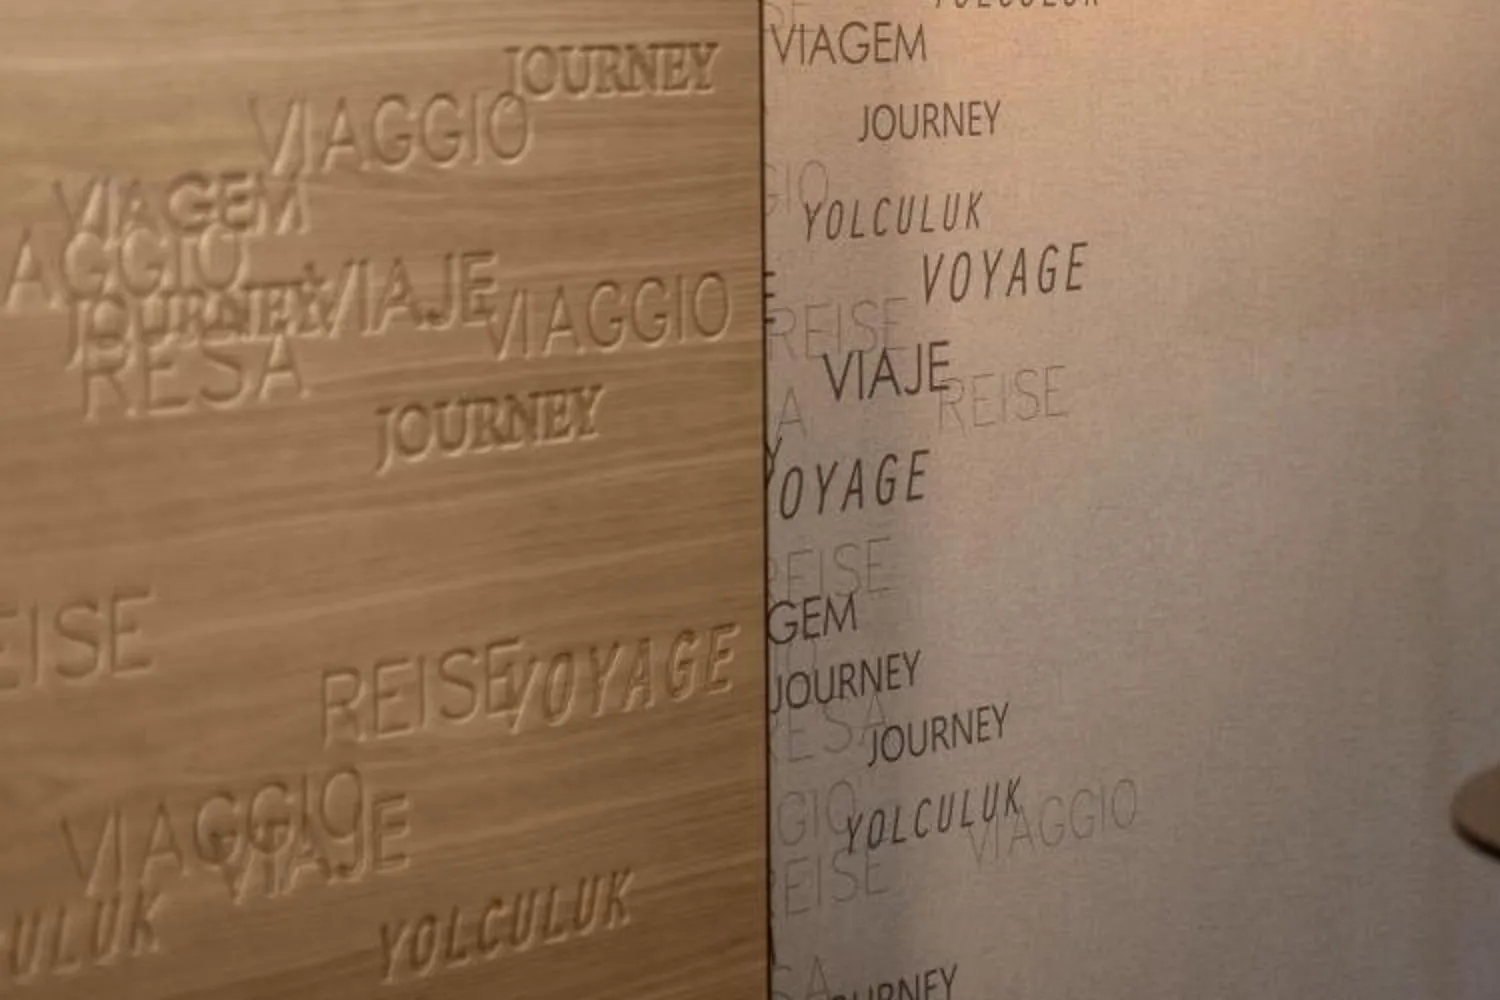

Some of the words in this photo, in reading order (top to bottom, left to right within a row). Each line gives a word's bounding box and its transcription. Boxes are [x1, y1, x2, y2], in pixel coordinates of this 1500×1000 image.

[504, 43, 719, 100] JOURNEY
[769, 20, 928, 65] VIAGEM
[247, 91, 536, 177] VIAGGIO
[857, 99, 1001, 143] JOURNEY
[803, 190, 984, 242] YOLCULUK
[922, 240, 1089, 305] VOYAGE
[485, 270, 732, 361] VIAGGIO
[822, 340, 951, 402] VIAJE
[937, 365, 1070, 437] REISE
[373, 384, 607, 478] JOURNEY
[768, 537, 892, 602] EISE
[767, 593, 858, 645] GEM
[320, 636, 524, 752] REISE
[510, 622, 741, 735] VOYAGE
[769, 649, 922, 716] JOURNEY
[867, 702, 1010, 768] JOURNEY
[846, 775, 1022, 855] YOLCULUK
[967, 778, 1138, 870] VIAGGIO
[378, 867, 636, 985] YOLCULUK
